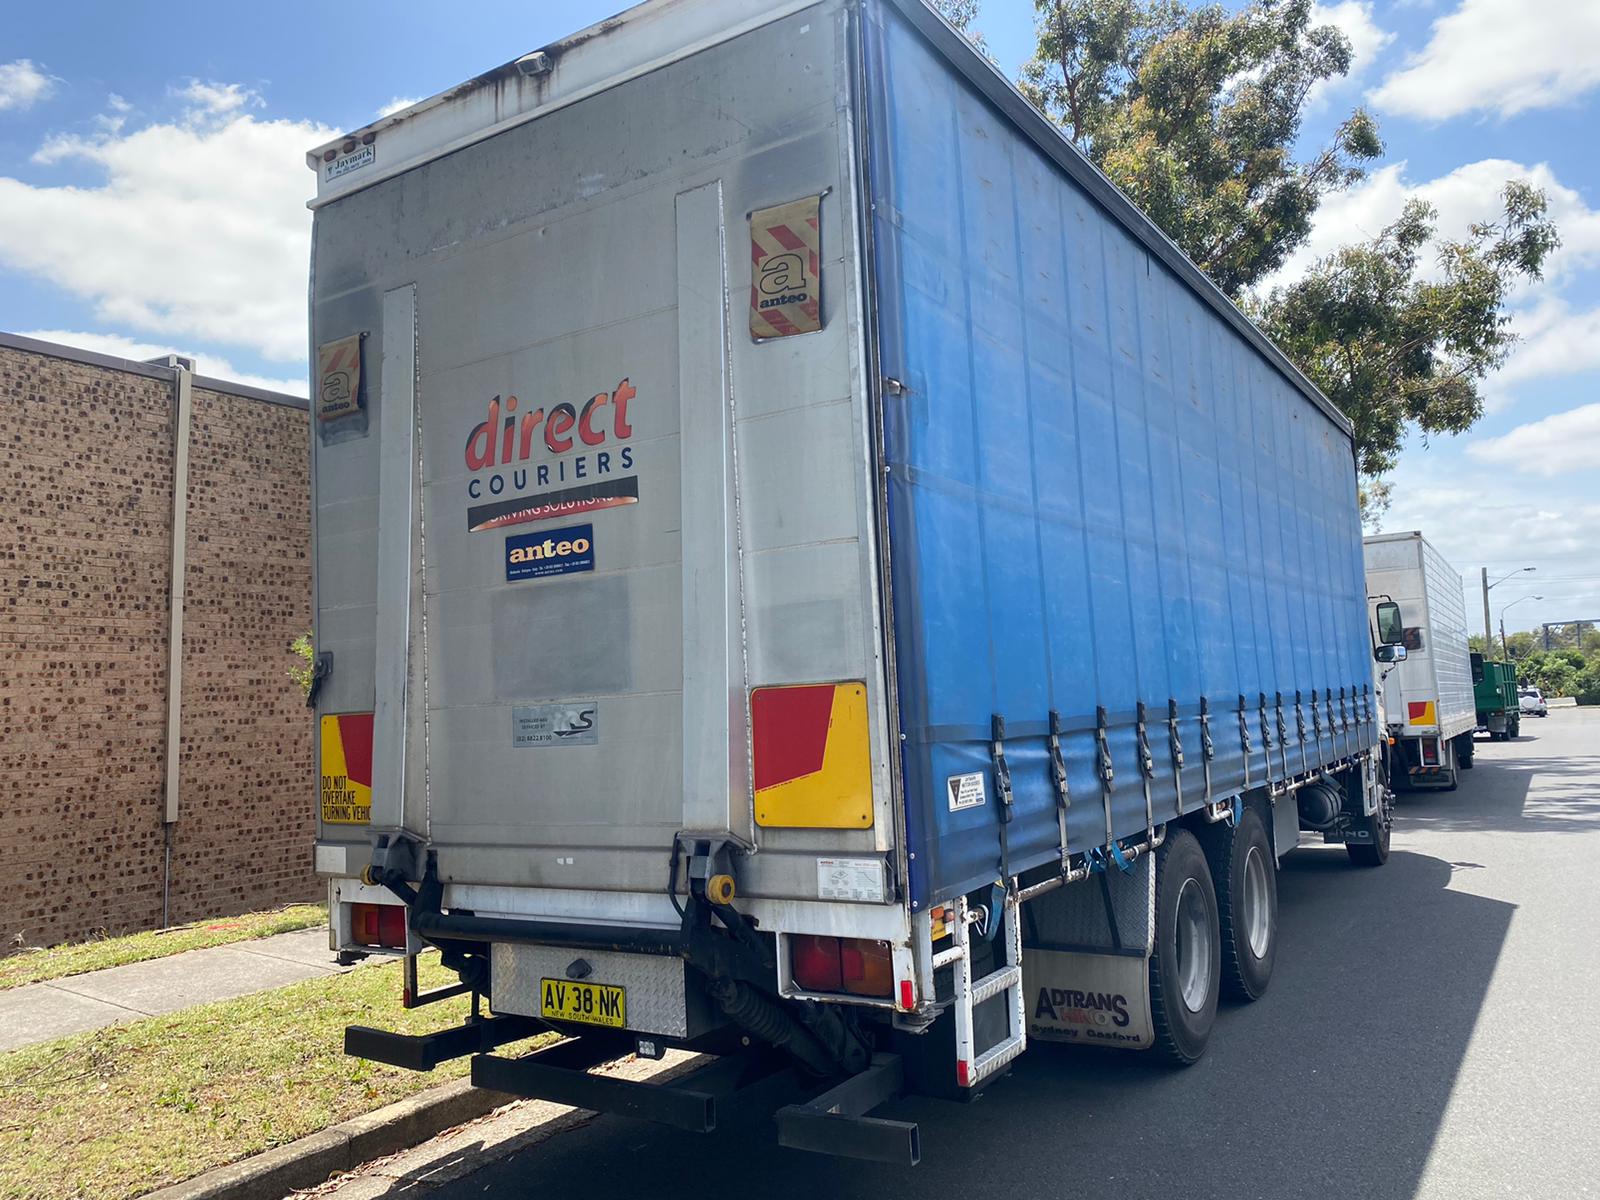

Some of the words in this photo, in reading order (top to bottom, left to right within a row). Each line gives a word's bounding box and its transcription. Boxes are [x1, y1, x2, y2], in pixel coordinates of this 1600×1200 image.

[335, 147, 372, 169] Jaymark
[760, 292, 807, 308] anteo
[322, 402, 350, 414] anteo
[465, 377, 637, 471] direct
[468, 447, 633, 498] COURIERS
[509, 538, 590, 563] anteo
[322, 775, 332, 790] DO
[333, 775, 347, 790] NOT
[322, 790, 356, 805] OVERTAKE
[322, 805, 351, 820] TURNING
[1035, 987, 1130, 1027] ADTRANS
[568, 1012, 590, 1021] SOUTH
[593, 1015, 614, 1025] WALES
[1031, 1023, 1079, 1037] Sydney
